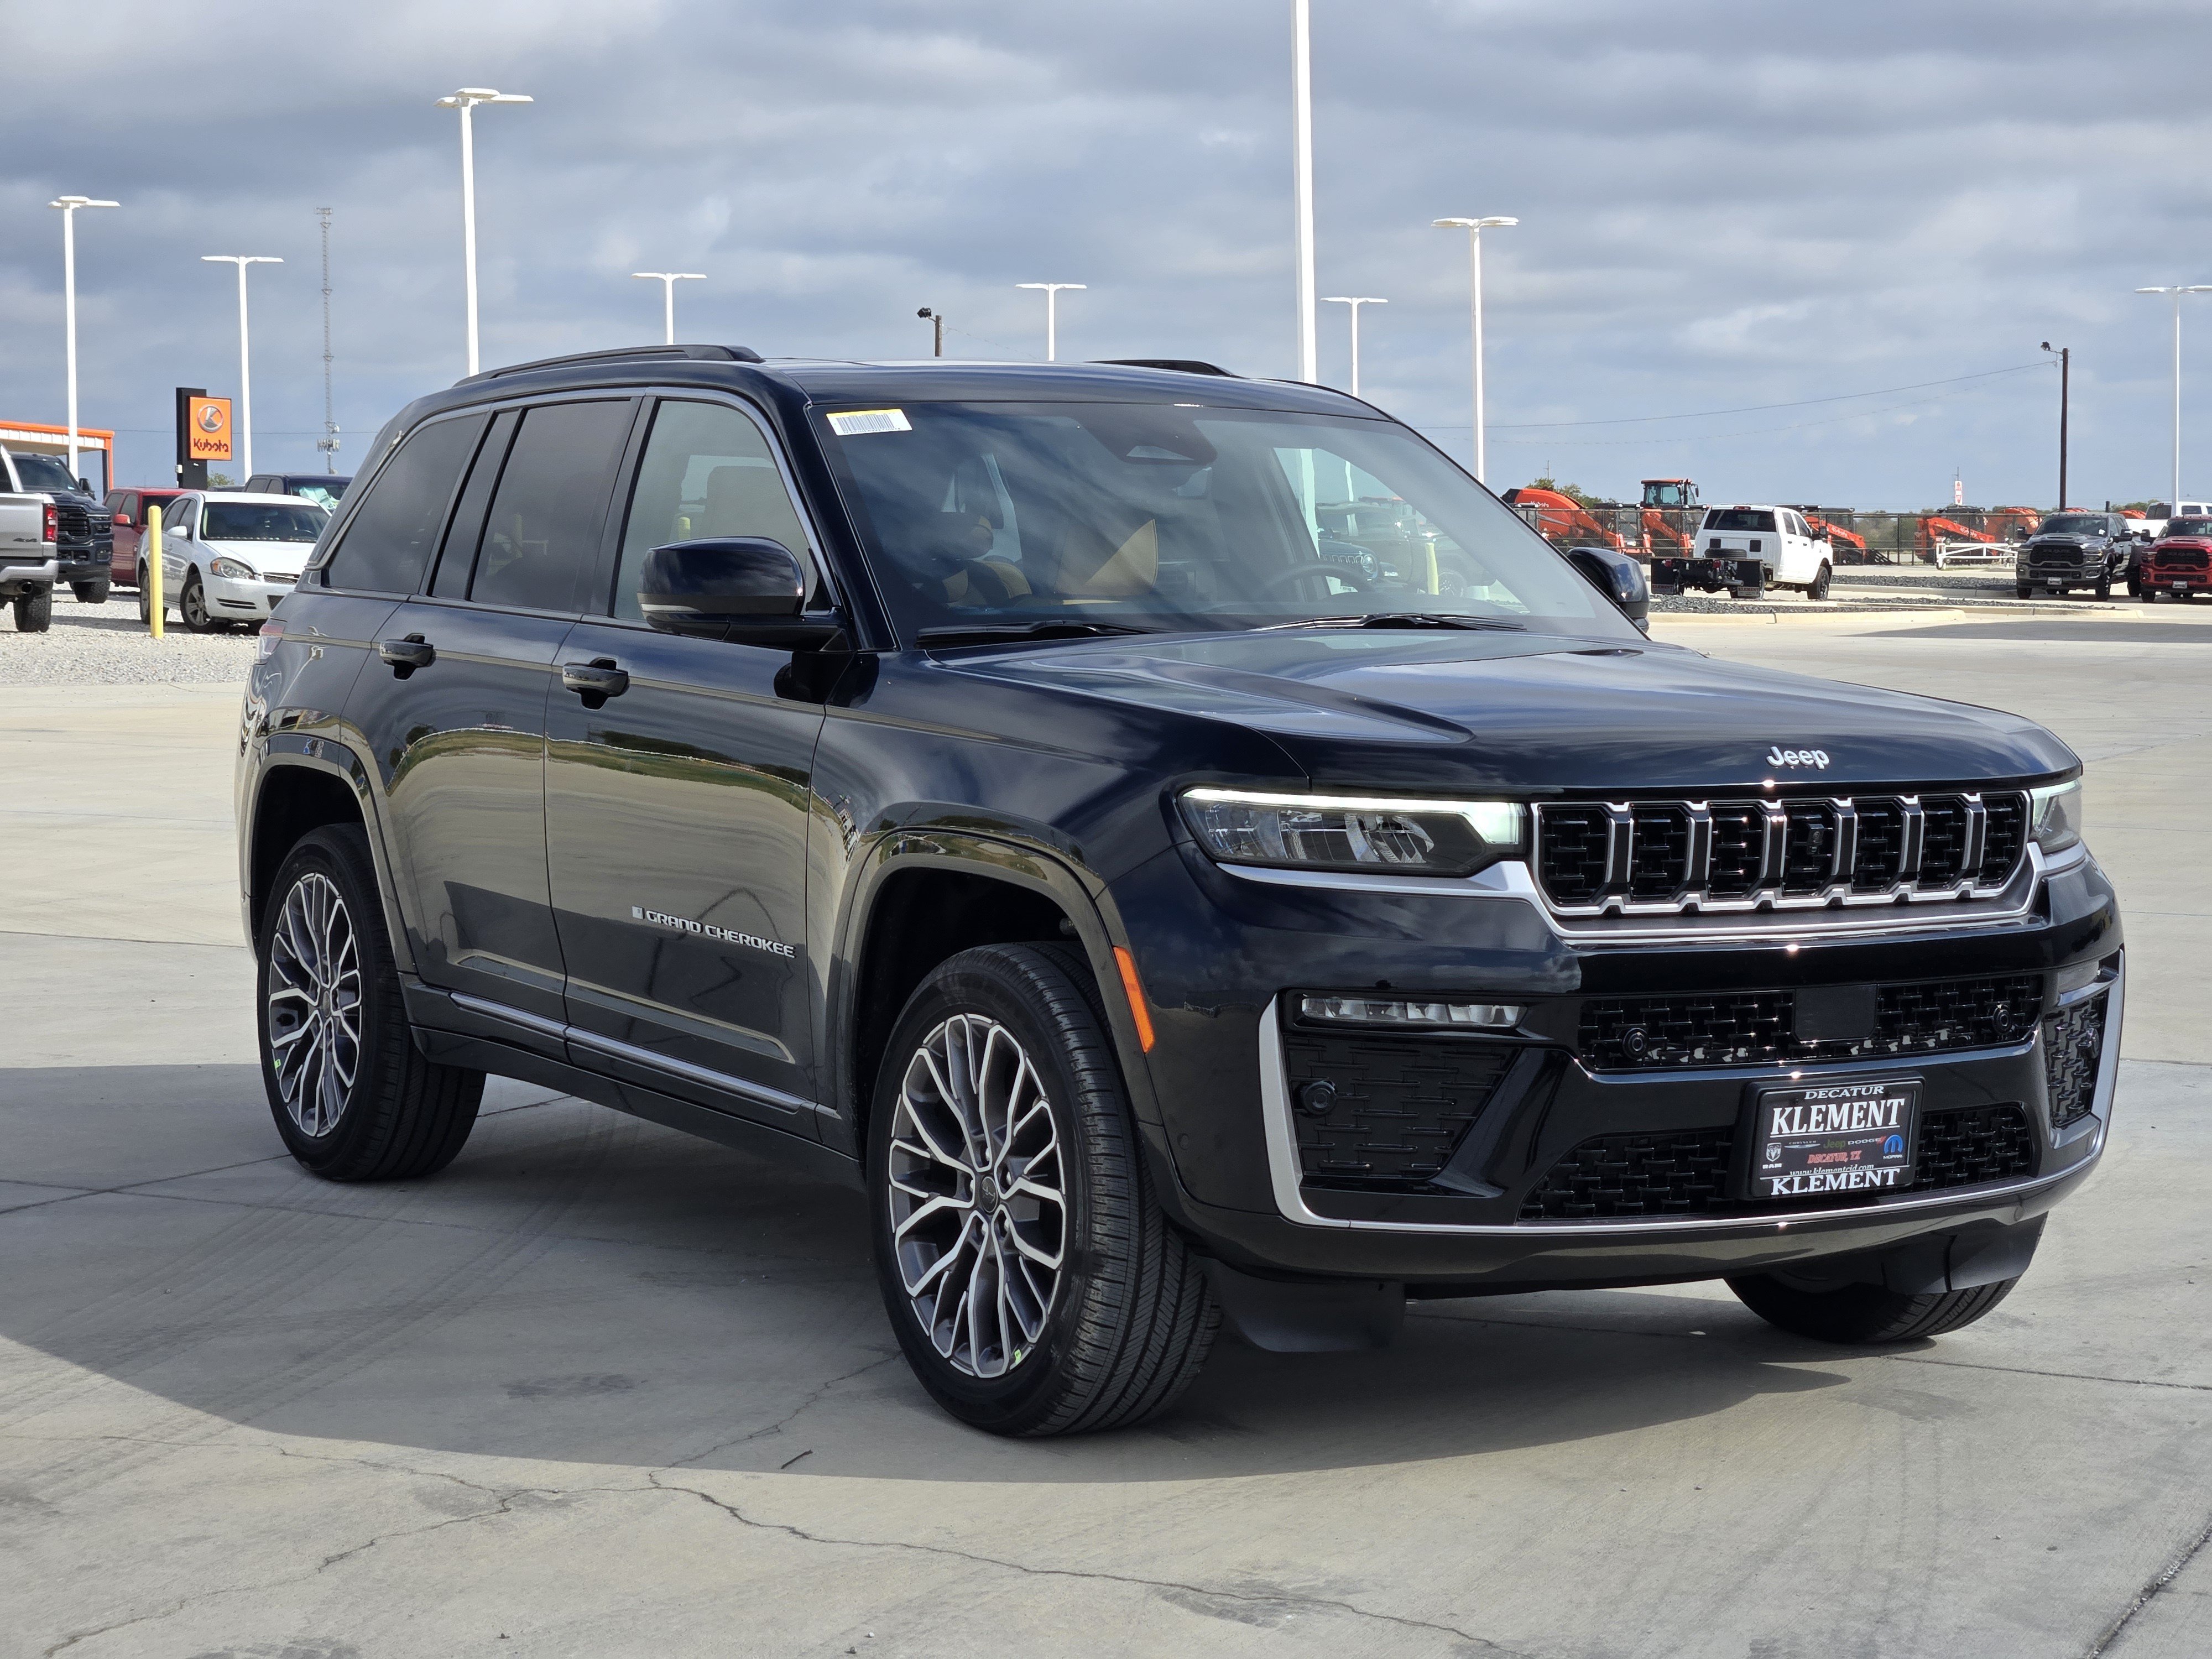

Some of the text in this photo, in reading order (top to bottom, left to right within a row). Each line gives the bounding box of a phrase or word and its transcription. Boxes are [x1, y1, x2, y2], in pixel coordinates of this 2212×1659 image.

[194, 438, 229, 452] Kubota
[1766, 746, 1829, 770] Jeep
[646, 910, 796, 958] GRAND CHEROKEE
[1804, 1086, 1884, 1100] DECATUR
[1770, 1098, 1905, 1135] KLEMENT
[1823, 1139, 1845, 1150] Jeep
[1807, 1150, 1862, 1164] DECATUR, TX
[1771, 1168, 1900, 1196] KLEMENT
